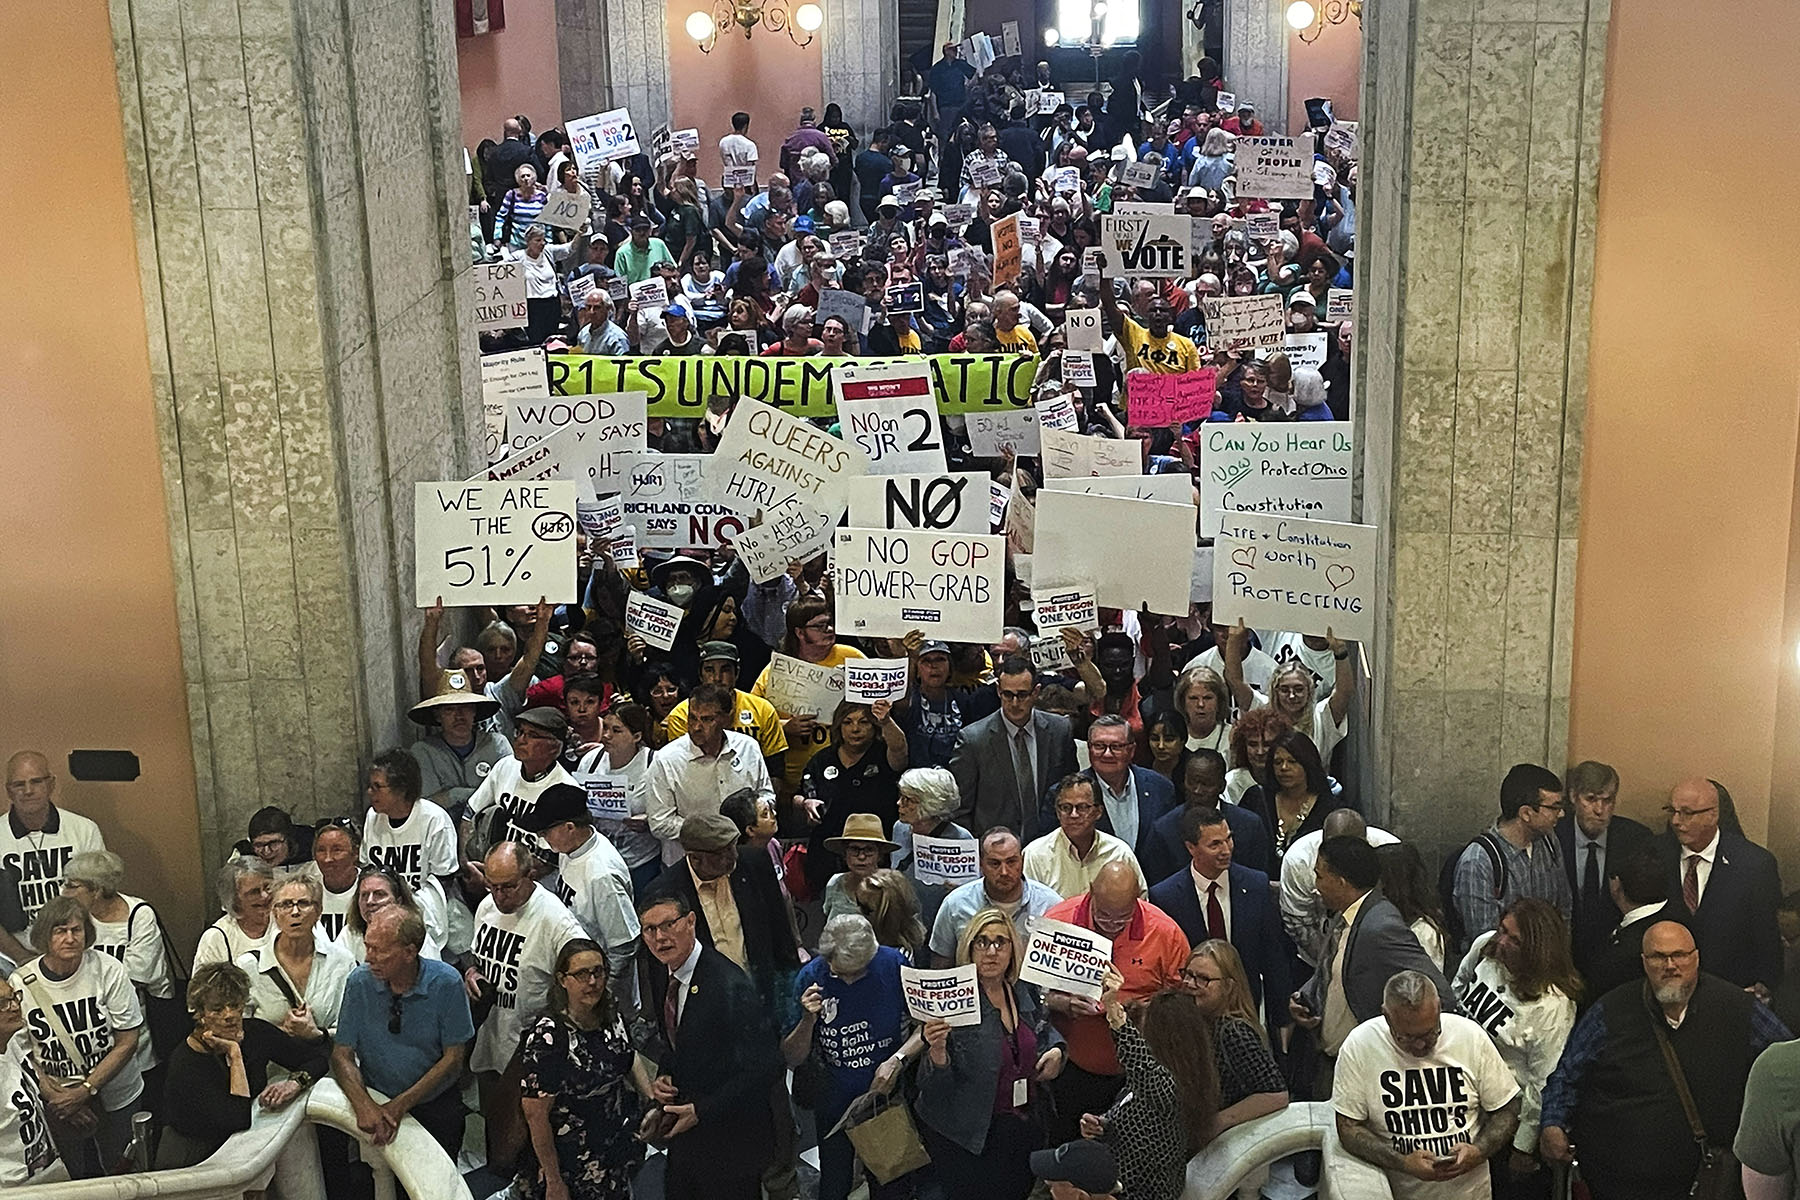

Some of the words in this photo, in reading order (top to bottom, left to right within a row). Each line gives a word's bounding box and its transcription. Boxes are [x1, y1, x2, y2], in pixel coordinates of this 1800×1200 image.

[1252, 138, 1293, 148] POWER
[1258, 158, 1302, 168] PEOPLE
[554, 203, 577, 218] NO
[1105, 218, 1143, 232] FIRST
[1115, 239, 1133, 251] WE
[1121, 224, 1185, 270] VOTE
[488, 265, 516, 280] FOR
[493, 286, 504, 300] A
[512, 302, 526, 317] US
[1071, 316, 1095, 328] NO
[517, 399, 616, 426] WOOD
[599, 422, 644, 442] SAYS
[850, 412, 881, 434] NO
[881, 419, 899, 432] on
[748, 409, 850, 474] QUEERS
[856, 433, 900, 461] SJR
[902, 408, 940, 452] 2
[487, 446, 551, 481] AMERICA
[1260, 459, 1310, 476] Protect
[1310, 462, 1348, 477] Ohio
[437, 488, 483, 512] WE
[500, 487, 549, 511] ARE
[623, 502, 691, 515] RICHLAND
[1222, 491, 1323, 512] Constitution
[470, 516, 512, 536] THE
[646, 518, 678, 530] SAYS
[689, 515, 745, 546] NO
[771, 511, 809, 540] HJR1
[1277, 521, 1352, 550] Constitution
[868, 536, 909, 565] NO
[931, 540, 989, 569] GOP
[1264, 550, 1317, 570] worth
[445, 544, 533, 587] 51%
[845, 568, 990, 603] POWER-GRAB
[1227, 571, 1362, 614] PROTECTING
[628, 606, 642, 617] ONE
[644, 613, 677, 629] PERSON
[1038, 605, 1058, 614] ONE
[1059, 601, 1094, 612] PERSON
[1039, 612, 1064, 624] ONE
[1065, 608, 1094, 620] VOTE
[627, 614, 646, 628] ONE
[647, 622, 673, 638] VOTE
[848, 681, 885, 689] PERSON
[849, 671, 879, 681] VOTE
[881, 671, 905, 680] ONE
[887, 680, 905, 688] ONE
[592, 790, 626, 799] PERSON
[598, 799, 627, 808] VOTE
[3, 846, 73, 882] SAVE
[369, 844, 422, 873] SAVE
[916, 850, 936, 859] ONE
[937, 855, 975, 864] PERSON
[917, 859, 942, 872] ONE
[944, 863, 976, 874] VOTE
[475, 922, 527, 968] SAVE
[1056, 935, 1091, 949] PROTECT
[1032, 938, 1057, 956] ONE
[1059, 948, 1107, 969] PERSON
[1029, 950, 1062, 970] ONE
[1065, 963, 1104, 980] VOTE
[906, 987, 928, 1000] ONE
[929, 986, 975, 1000] PERSON
[922, 979, 956, 988] PROTECT
[908, 997, 935, 1012] ONE
[937, 997, 975, 1012] VOTE
[1462, 981, 1515, 1038] AVE
[820, 1026, 838, 1037] We
[842, 1042, 876, 1058] show
[1380, 1066, 1468, 1108] SAVE
[1384, 1105, 1469, 1136] OHIO'S
[1391, 1128, 1472, 1157] CONSTITUTION
